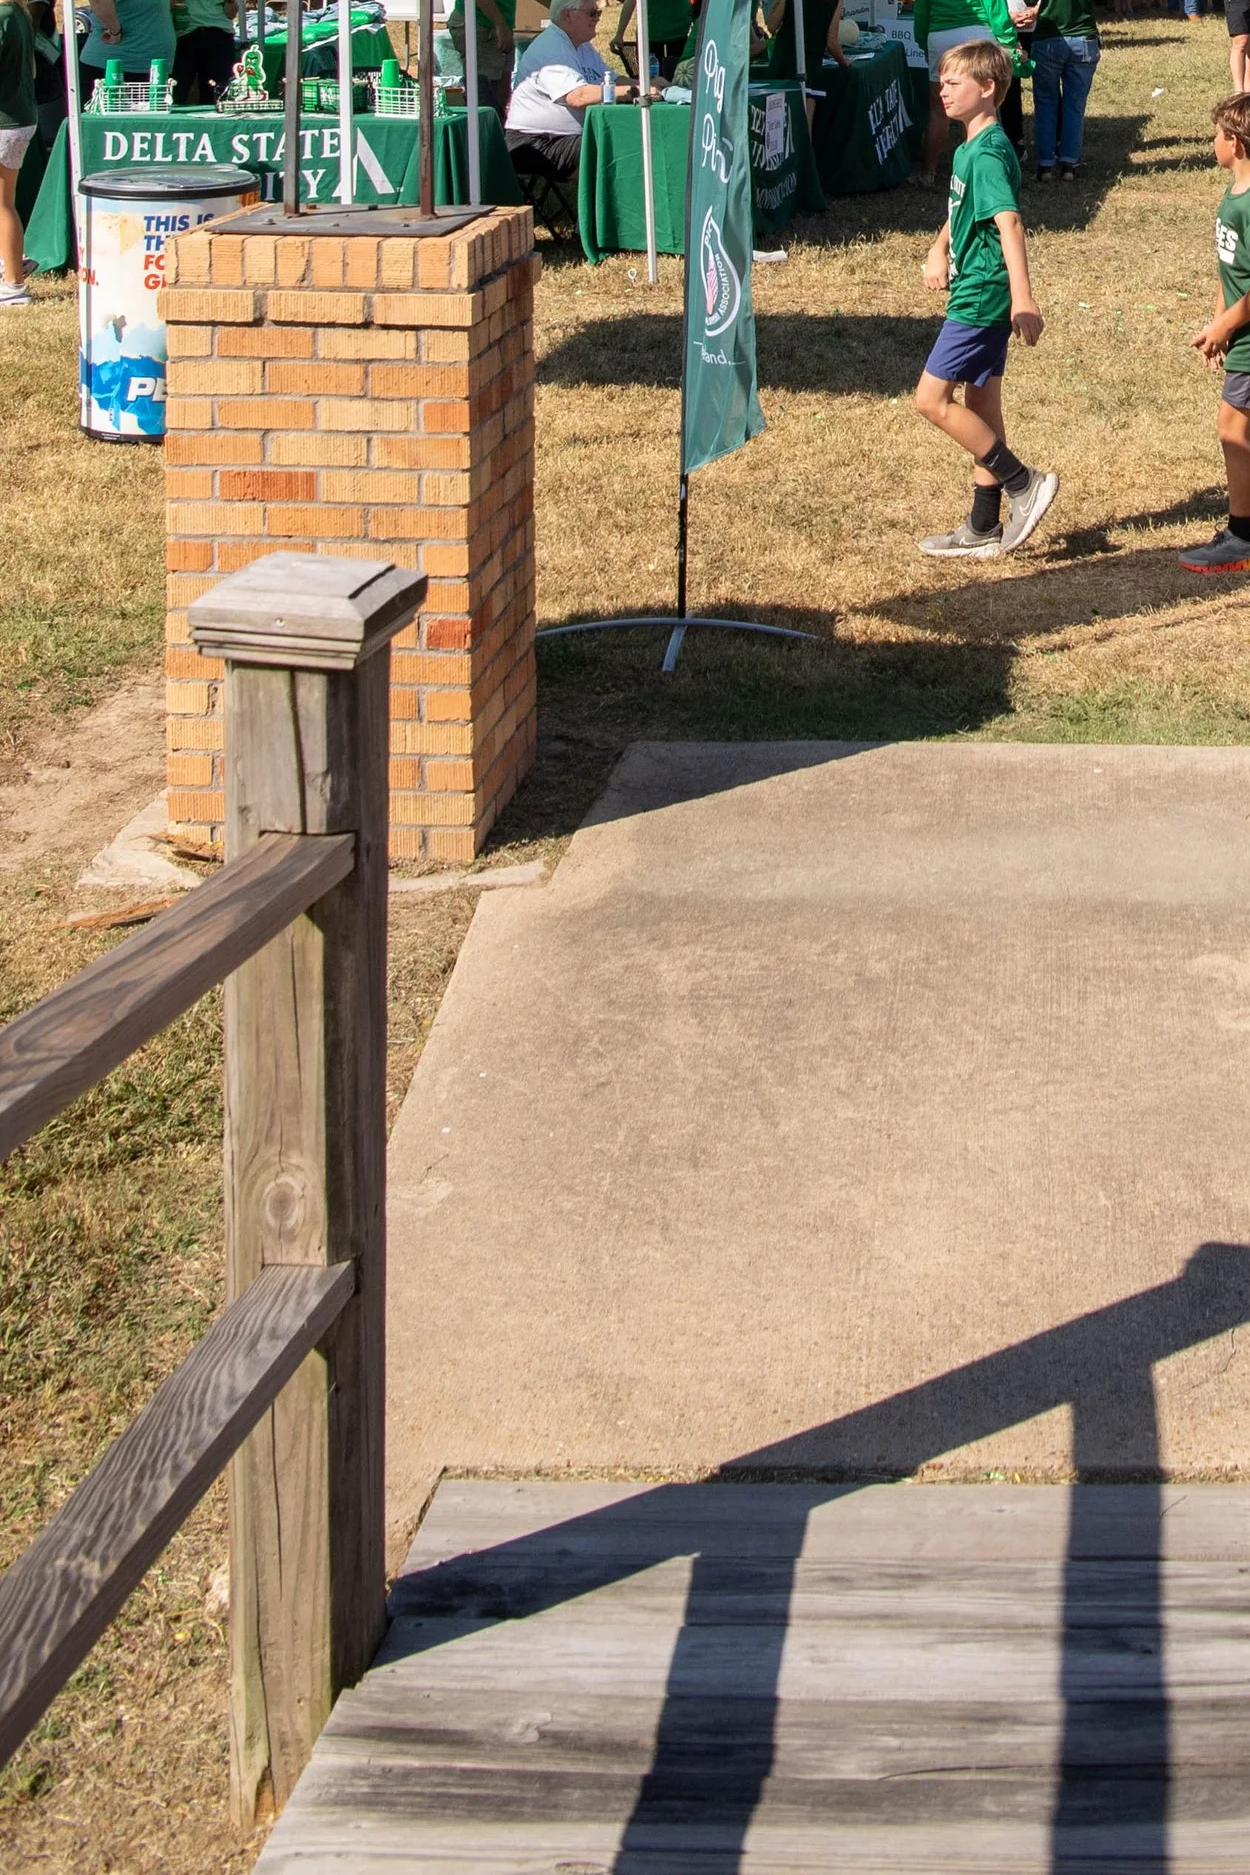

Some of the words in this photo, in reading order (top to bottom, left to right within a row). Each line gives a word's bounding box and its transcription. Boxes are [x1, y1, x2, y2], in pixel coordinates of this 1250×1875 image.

[891, 30, 912, 41] BBQ
[704, 39, 726, 114] Pig
[103, 131, 217, 163] DELTA
[144, 215, 190, 232] THIS
